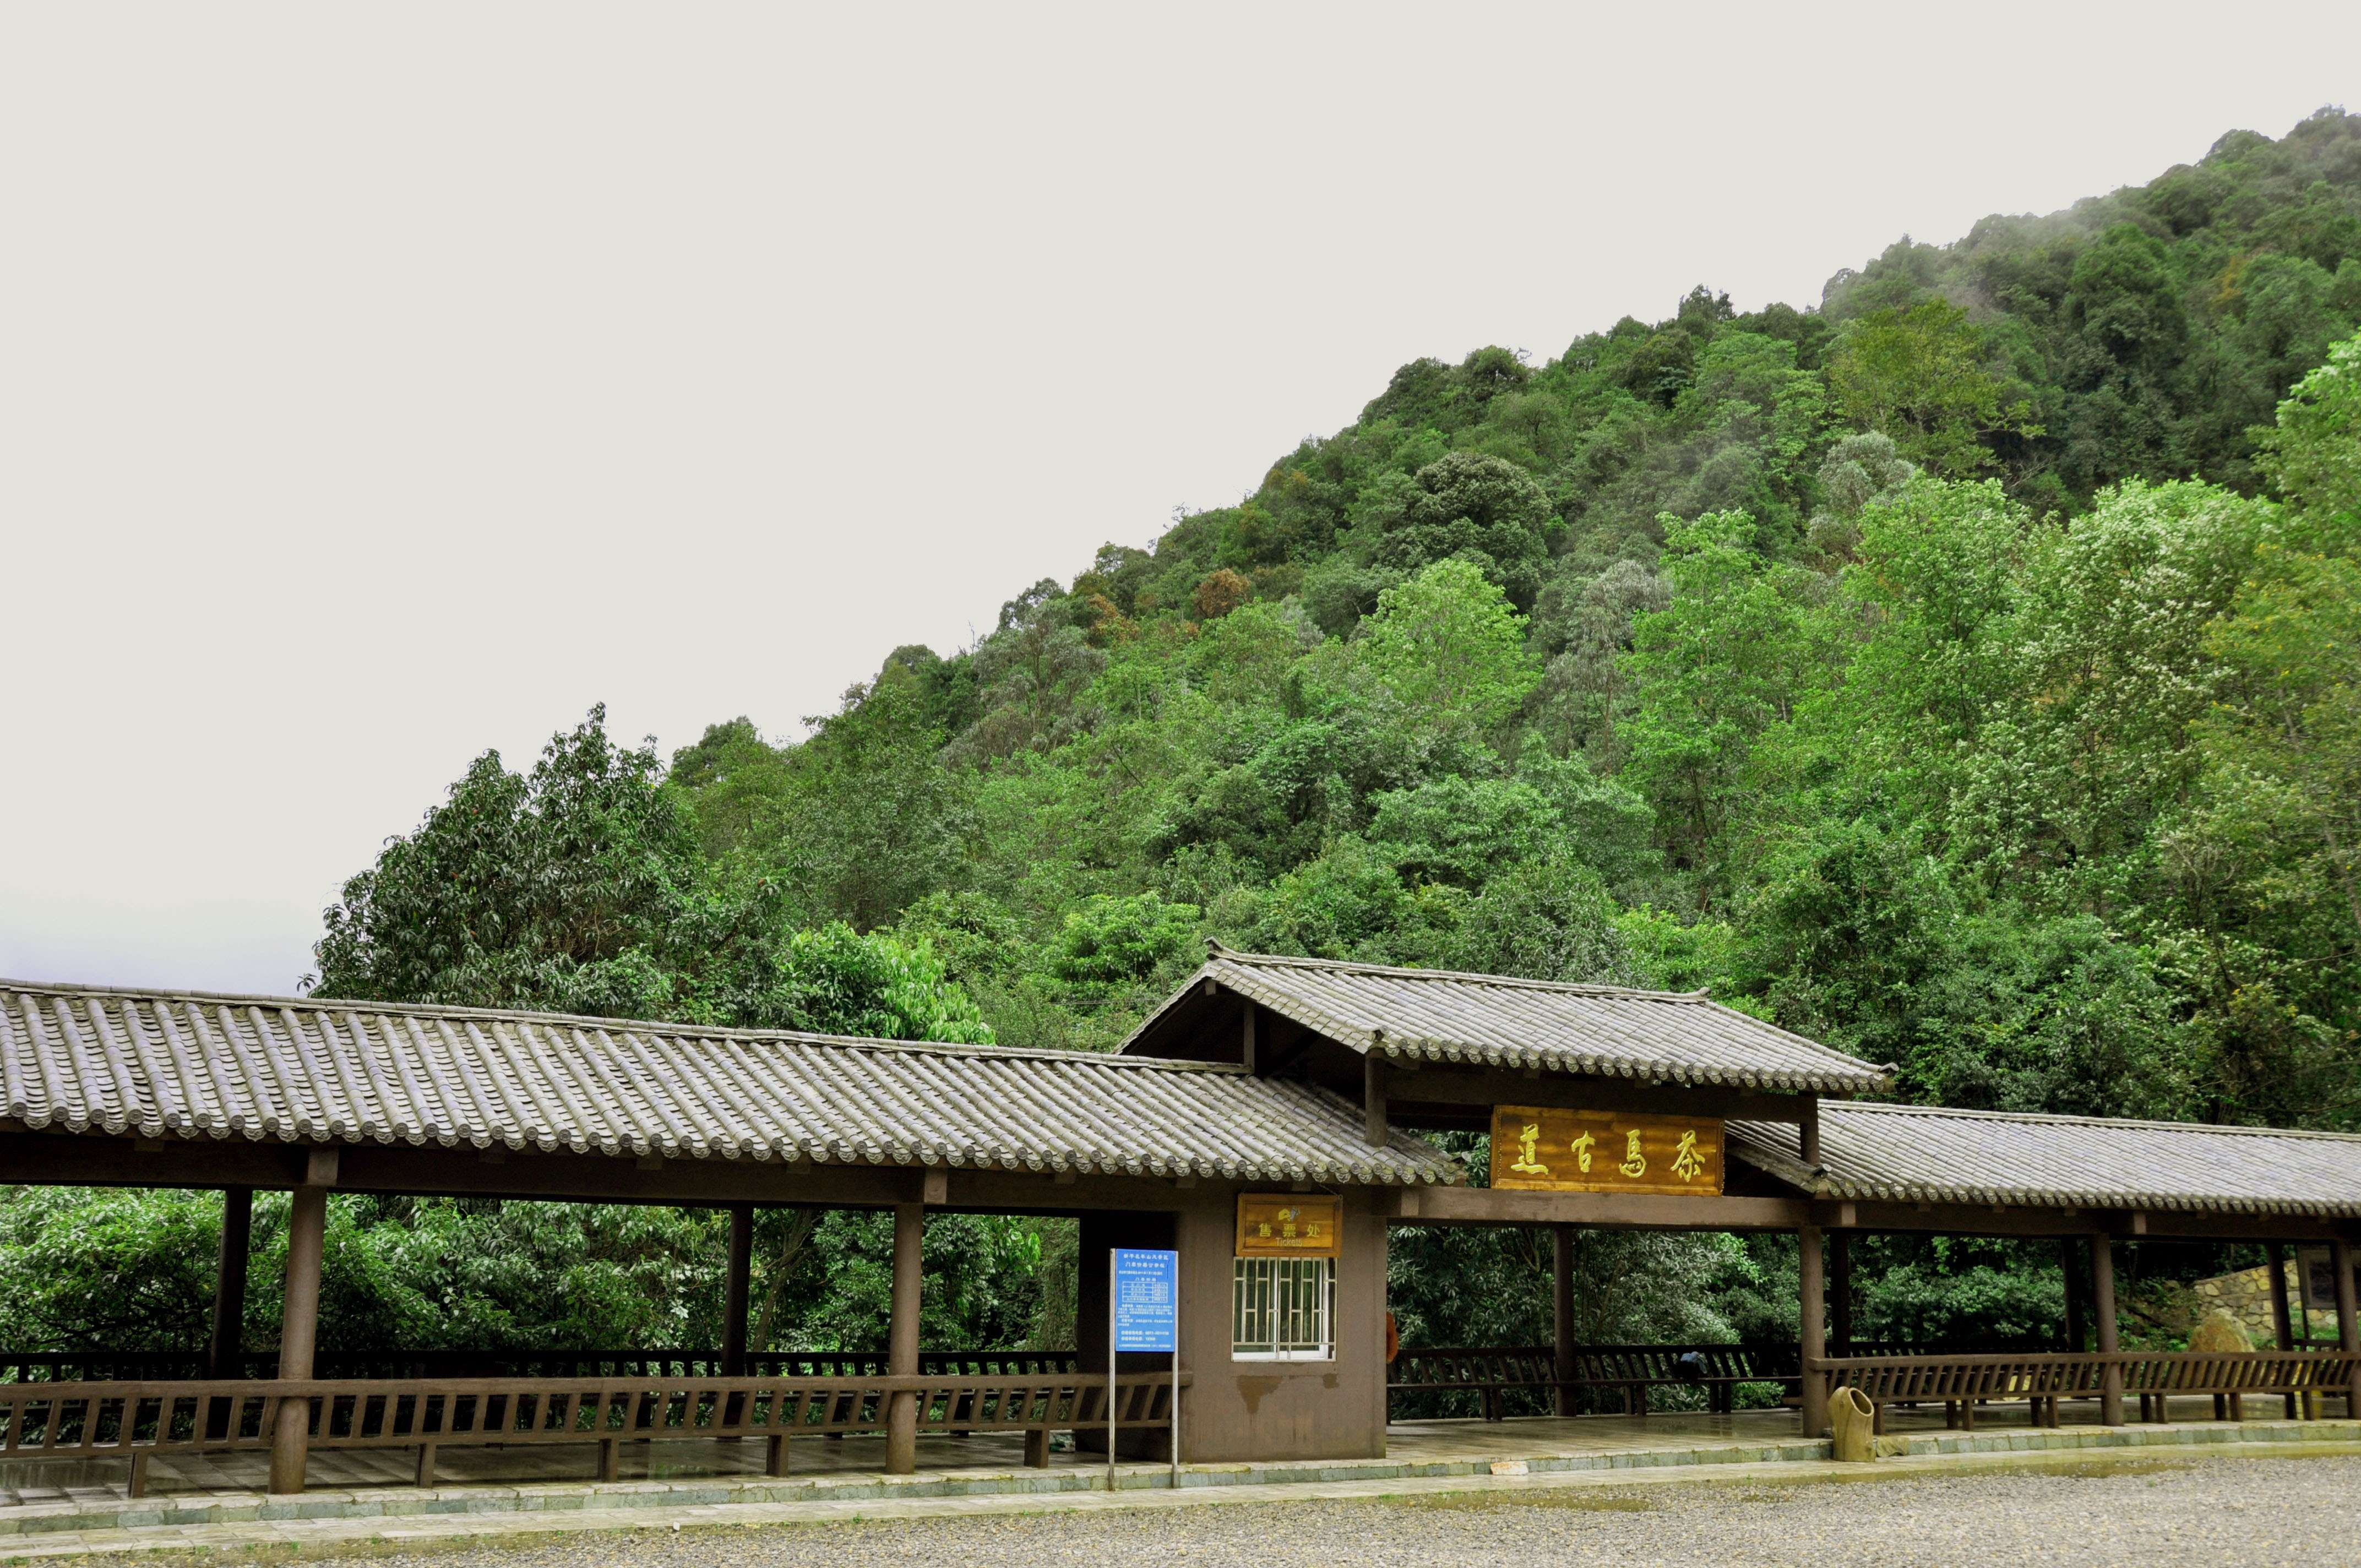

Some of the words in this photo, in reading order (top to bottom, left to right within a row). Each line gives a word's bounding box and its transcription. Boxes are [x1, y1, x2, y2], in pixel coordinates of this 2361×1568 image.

[1259, 1222, 1320, 1238] 售票处
[1276, 1237, 1303, 1248] Tickets
